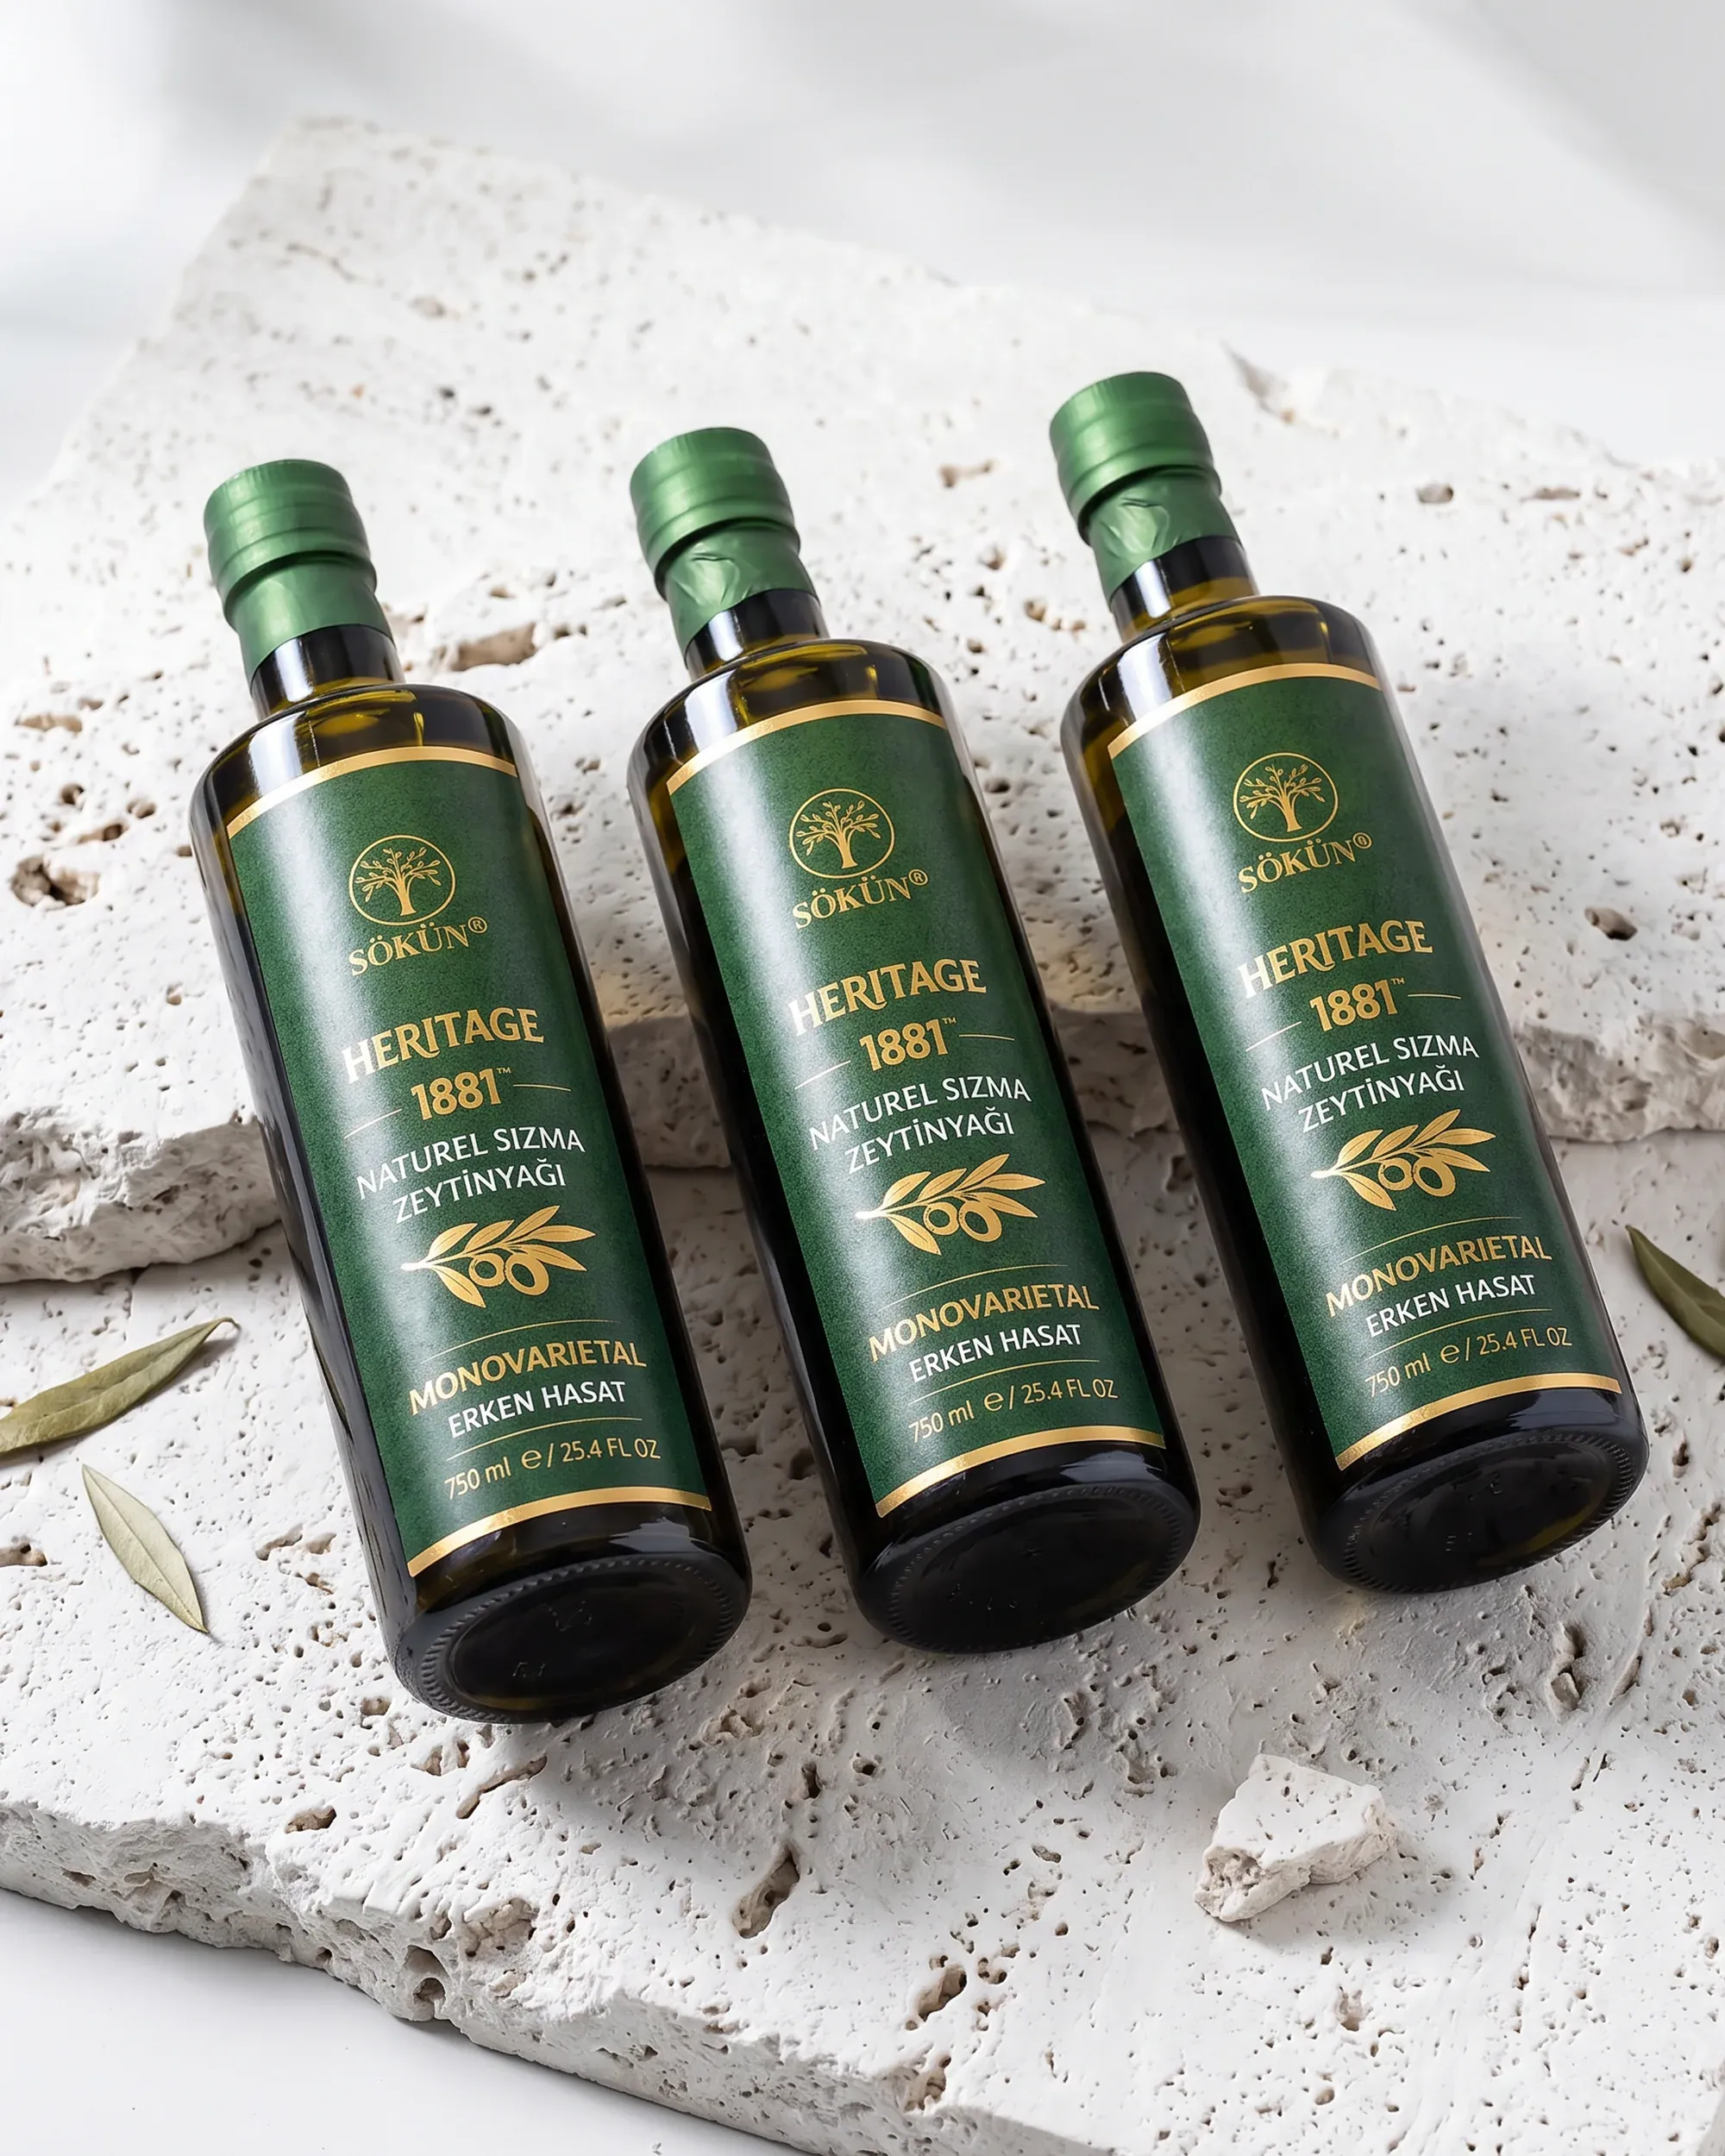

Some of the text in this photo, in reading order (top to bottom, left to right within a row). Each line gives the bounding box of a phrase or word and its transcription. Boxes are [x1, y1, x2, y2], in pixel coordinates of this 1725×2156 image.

[1237, 920, 1433, 999] HERITAGE
[787, 958, 987, 1037] HERITAGE
[342, 1007, 544, 1085] HERITAGE
[1261, 1035, 1479, 1111] NATUREL SIZMA
[808, 1076, 1032, 1150] NATUREL SIZMA
[1298, 1064, 1465, 1133] ZEYTİNYAĞI
[356, 1126, 586, 1200] NATUREL SIZMA
[844, 1106, 1014, 1175] ZEYTİNYAĞI
[392, 1158, 567, 1224] ZEYTİNYAĞI
[1325, 1235, 1552, 1318] MONOVARIETAL
[1365, 1275, 1536, 1337] ERKEN HASAT
[869, 1283, 1100, 1362] MONOVARIETAL
[909, 1324, 1082, 1382] ERKEN HASAT
[409, 1340, 647, 1415] MONOVARIETAL
[1364, 1366, 1401, 1398] 750
[1404, 1352, 1432, 1379] ml
[1477, 1331, 1518, 1356] 25.4
[1521, 1327, 1546, 1347] FL
[1546, 1327, 1572, 1346] OZ
[448, 1381, 625, 1438] ERKEN HASAT
[908, 1412, 944, 1444] 750
[948, 1400, 975, 1426] ml
[1020, 1383, 1063, 1405] 25.4
[1066, 1379, 1090, 1399] FL
[1093, 1379, 1119, 1399] OZ
[444, 1468, 480, 1500] 750
[485, 1457, 511, 1484] ml
[560, 1439, 602, 1463] 25.4
[606, 1438, 631, 1457] FL
[634, 1438, 662, 1459] OZ
